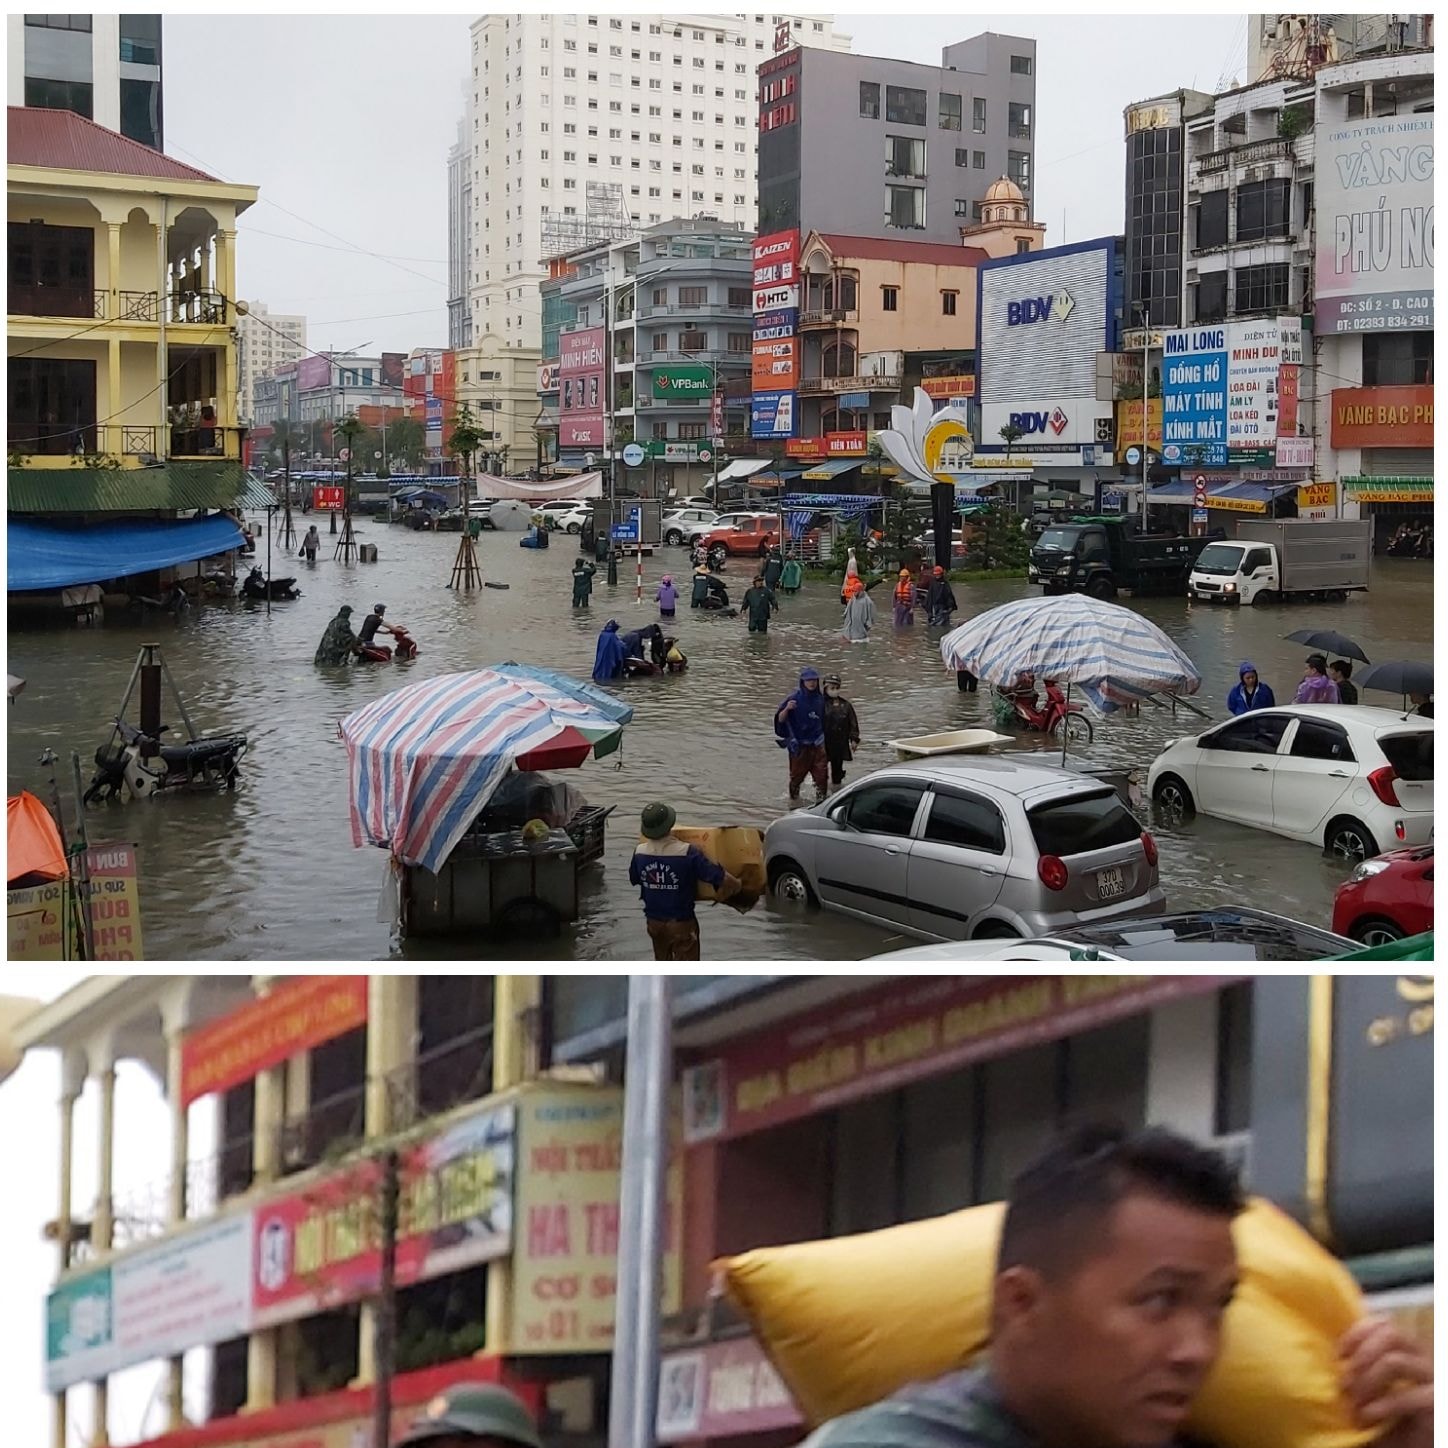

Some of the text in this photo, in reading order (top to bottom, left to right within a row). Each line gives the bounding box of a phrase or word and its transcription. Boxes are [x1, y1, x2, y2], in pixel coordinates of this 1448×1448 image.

[1335, 140, 1434, 190] VÀNG
[1335, 195, 1392, 275] PHÚ
[755, 241, 791, 260] KAIZEN
[767, 291, 789, 304] HTC
[1406, 297, 1429, 309] CAO
[1007, 295, 1053, 326] BIDV
[1166, 333, 1189, 354] MAI
[1193, 330, 1224, 351] LONG
[1233, 347, 1259, 360] MINH
[561, 351, 582, 370] MINH
[1169, 358, 1220, 384] ĐỒNG HỒ
[671, 378, 709, 389] VPBank
[1165, 388, 1224, 413] MÁY TÍNH
[1009, 411, 1049, 434] BIDV
[1338, 402, 1373, 425] VÀNG
[1377, 404, 1409, 428] BẠC
[1165, 415, 1223, 440] KÍNH MẮT
[1309, 495, 1329, 506] BẠC
